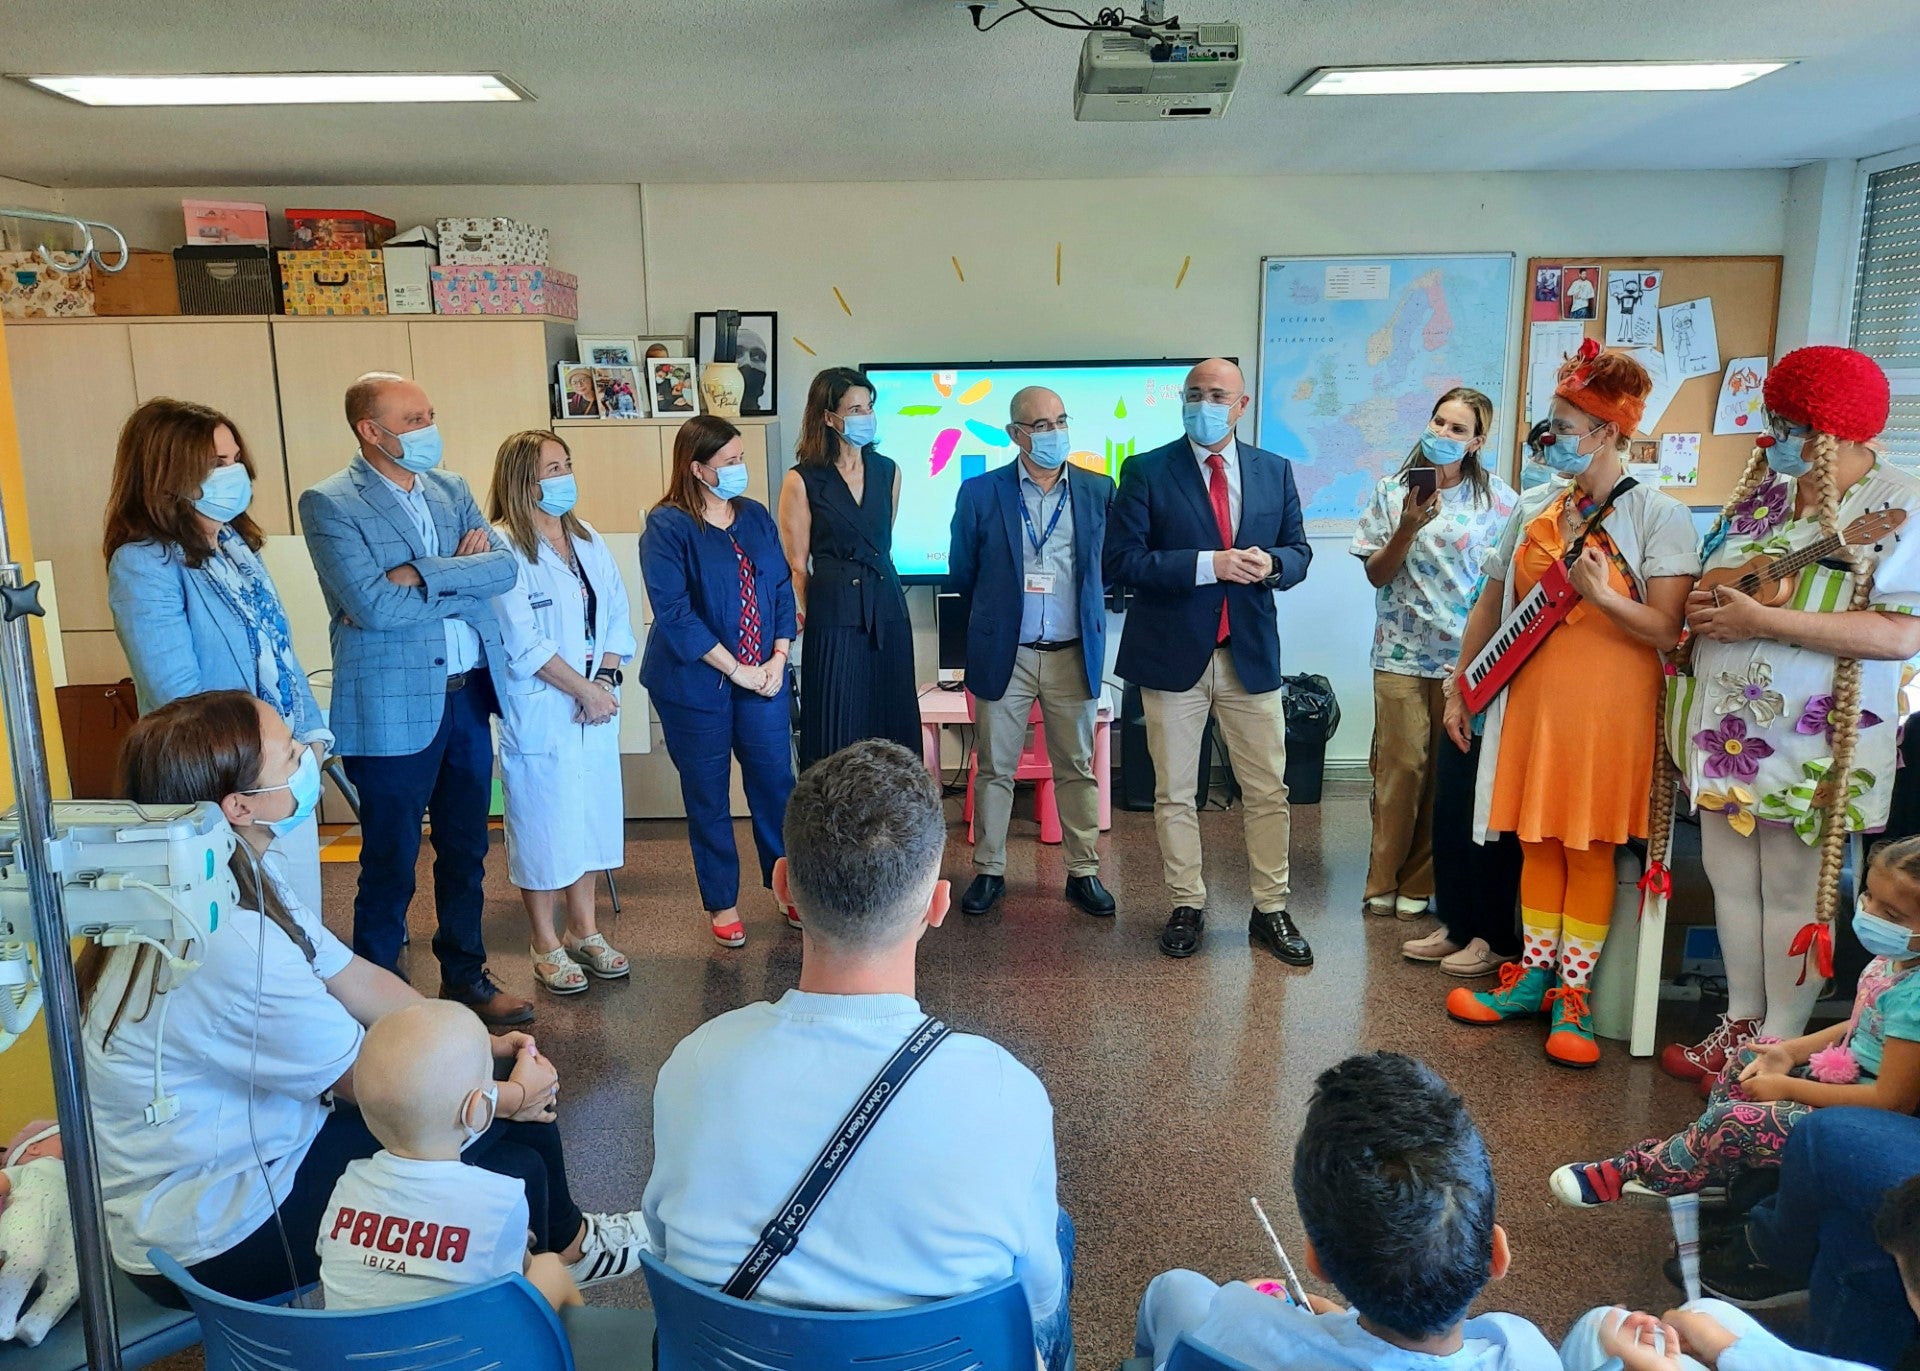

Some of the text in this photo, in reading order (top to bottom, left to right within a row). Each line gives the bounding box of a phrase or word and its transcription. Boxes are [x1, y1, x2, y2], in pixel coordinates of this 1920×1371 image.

[1721, 401, 1747, 420] LOVE
[927, 552, 949, 560] HOS
[910, 1031, 934, 1054] Jeans
[824, 1081, 891, 1169] Calvin Klein Jeans
[330, 1206, 470, 1263] PACHA
[363, 1254, 406, 1273] IBIZA
[748, 1247, 772, 1275] Jeans
